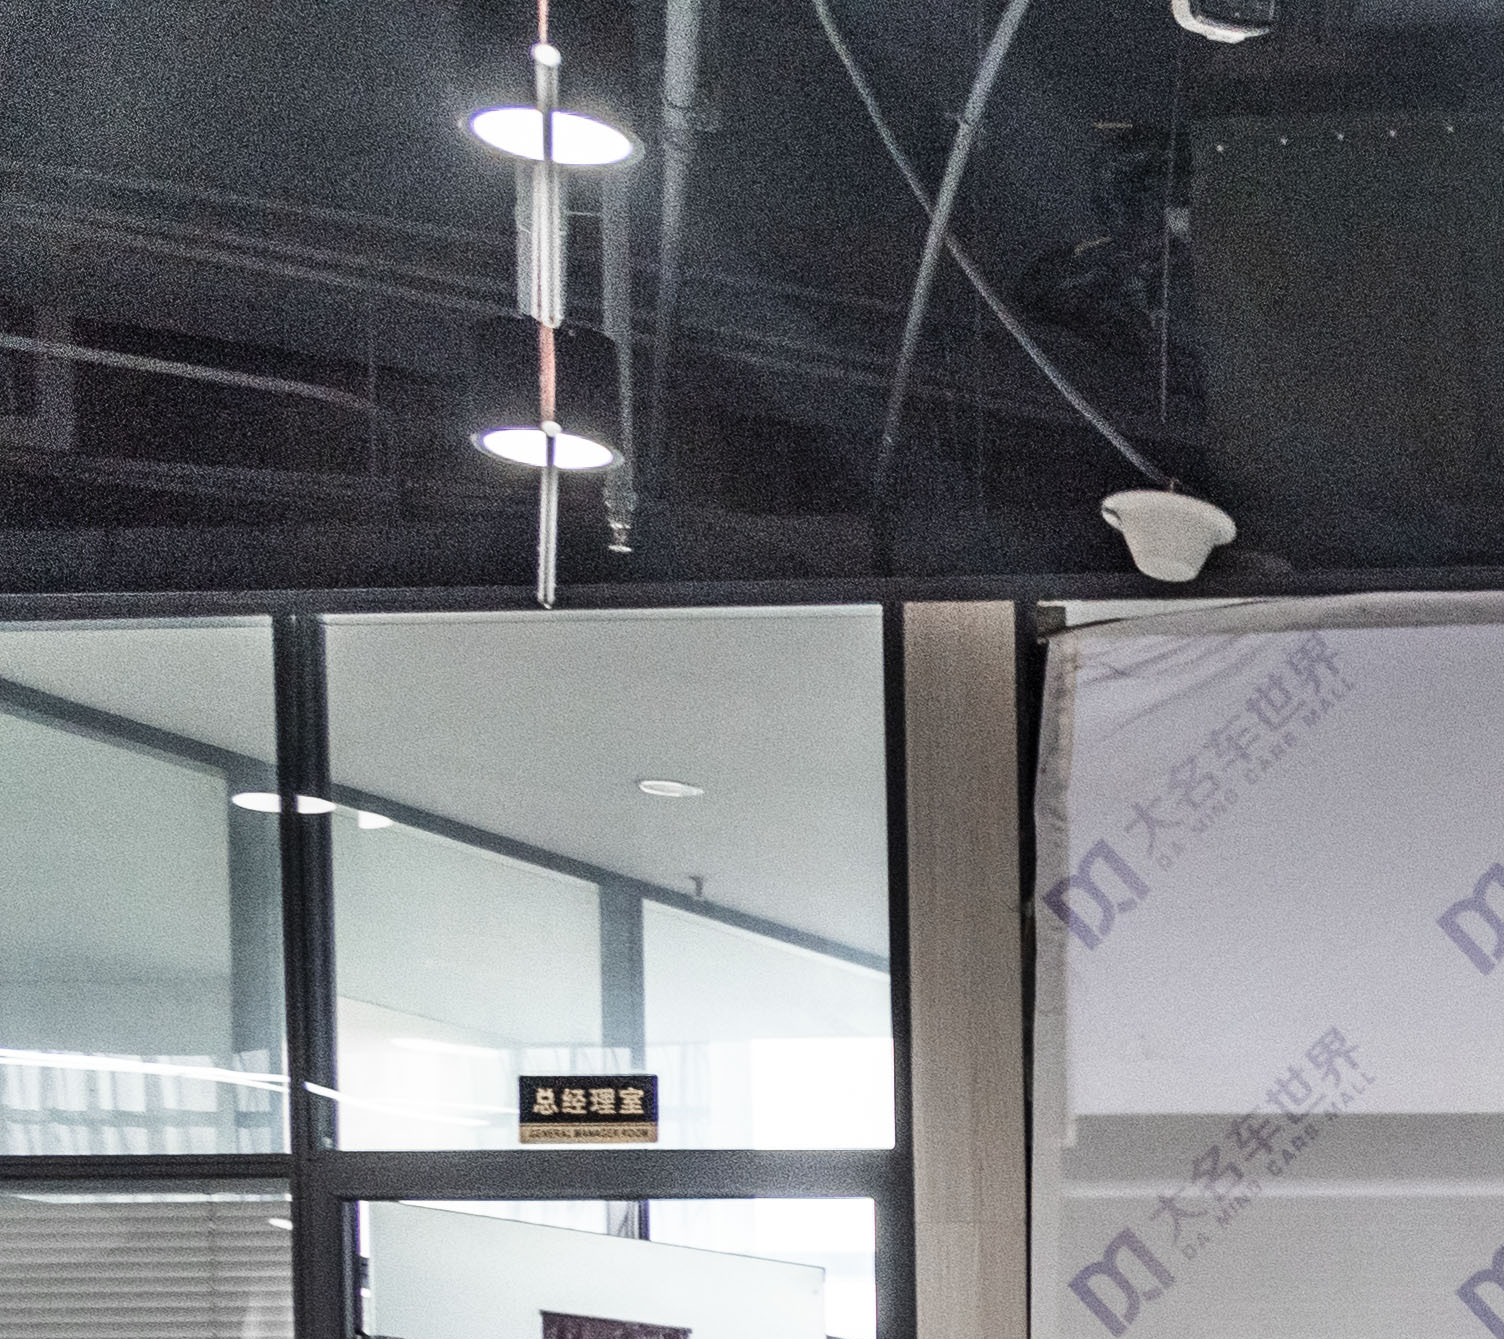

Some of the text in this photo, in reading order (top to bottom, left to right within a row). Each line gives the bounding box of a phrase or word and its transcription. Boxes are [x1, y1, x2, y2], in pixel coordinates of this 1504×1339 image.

[1127, 633, 1340, 859] 大名车世界
[532, 1086, 645, 1116] 总经理室
[1150, 1027, 1360, 1247] 大名车世界
